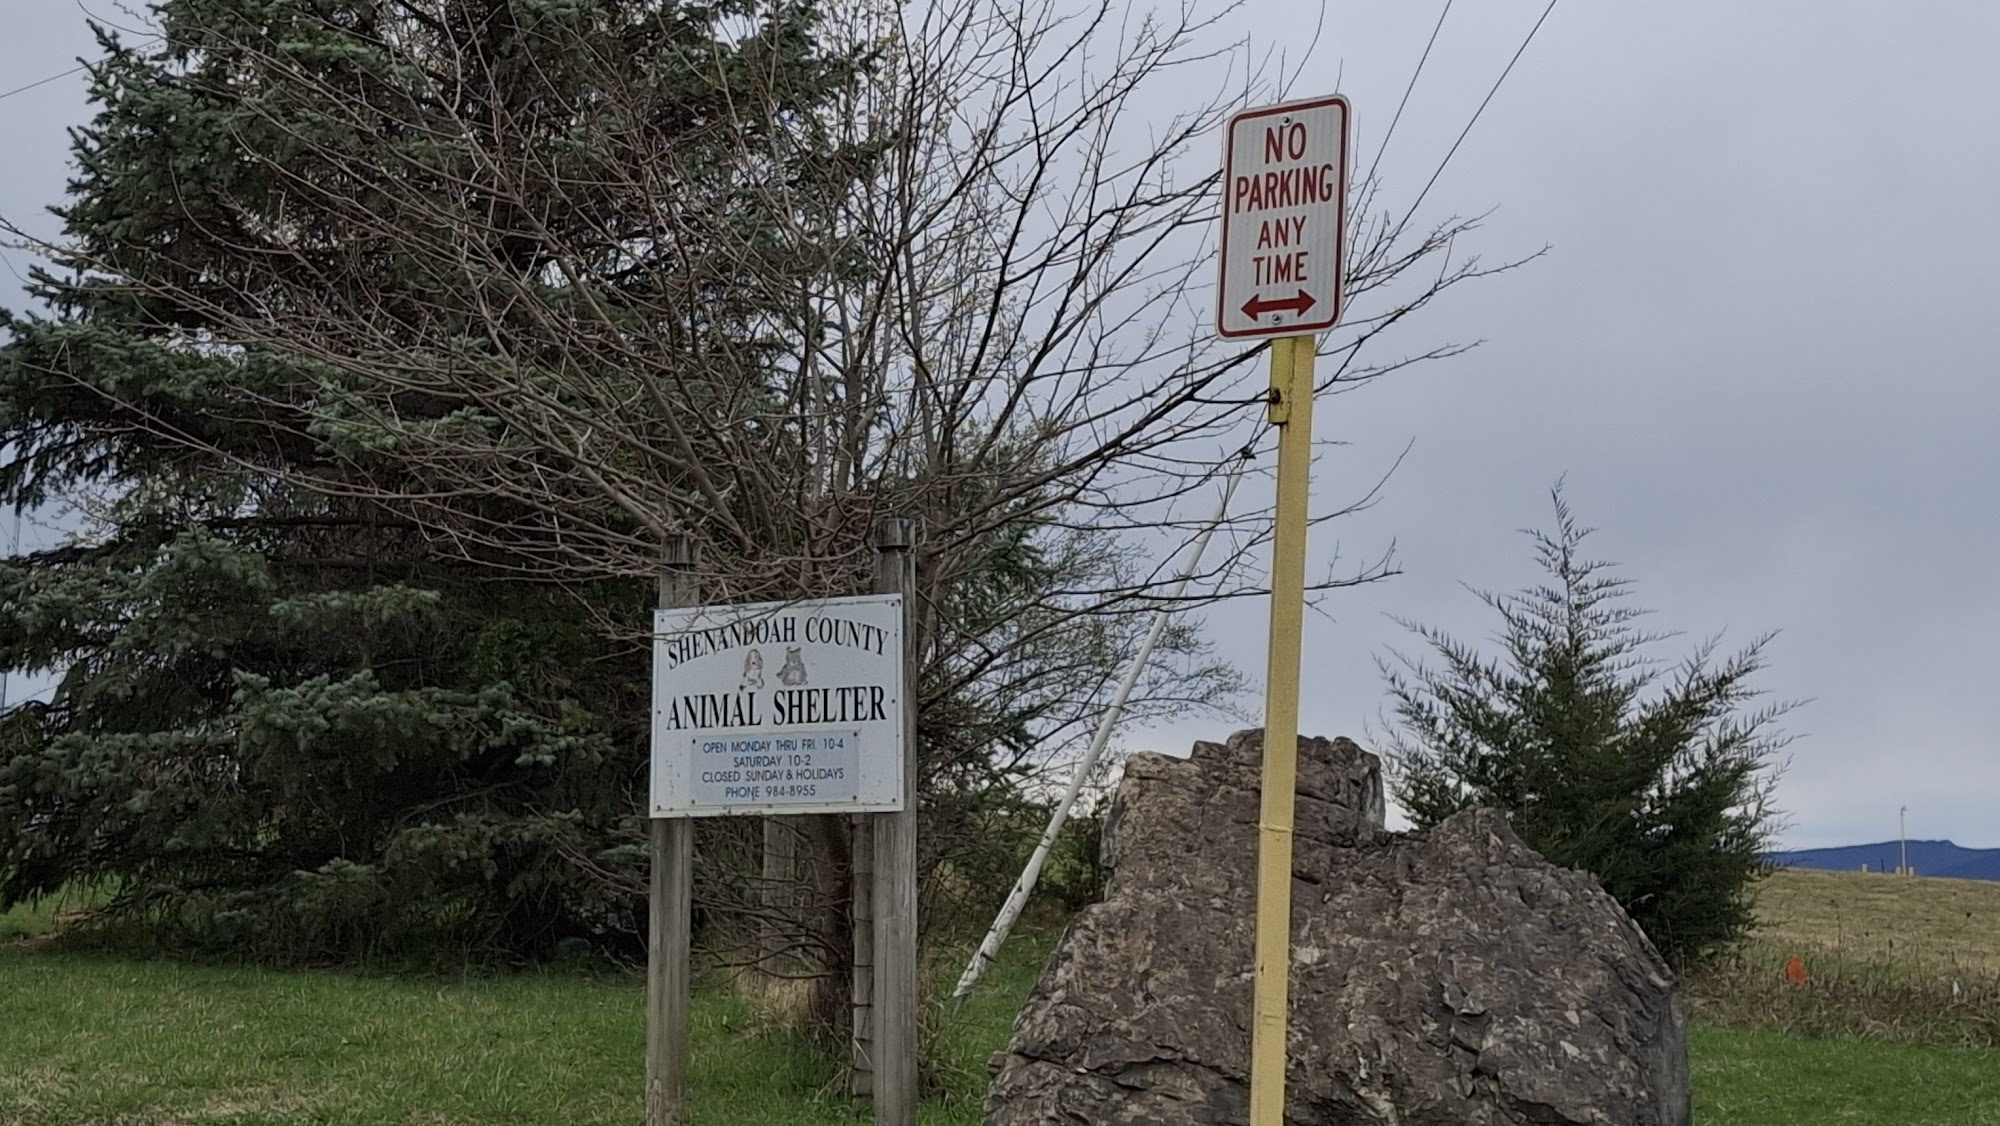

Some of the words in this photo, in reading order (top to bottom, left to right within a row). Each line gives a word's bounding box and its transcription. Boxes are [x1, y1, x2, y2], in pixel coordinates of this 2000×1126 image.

[1265, 122, 1307, 165] NO
[1234, 163, 1333, 214] PARKING
[1257, 215, 1307, 250] ANY
[1252, 251, 1309, 286] TIME
[668, 616, 797, 670] SHENANDOAH
[805, 616, 890, 656] COUNTY
[666, 691, 762, 731] ANIMAL
[773, 685, 887, 726] SHELTER
[702, 742, 727, 754] OPEN
[731, 740, 772, 752] MONDAY
[776, 739, 798, 751] THRU
[801, 738, 817, 750] FRI.
[823, 738, 844, 750] 10-4
[733, 756, 782, 768] SATURDAY
[788, 755, 811, 766] 10-2
[702, 771, 741, 783] CLOSED
[745, 769, 783, 782] SUNDAY
[785, 769, 794, 781] &
[796, 768, 845, 780] HOLIDAYS
[725, 786, 760, 798] PHONE
[765, 785, 816, 797] 984-8955
